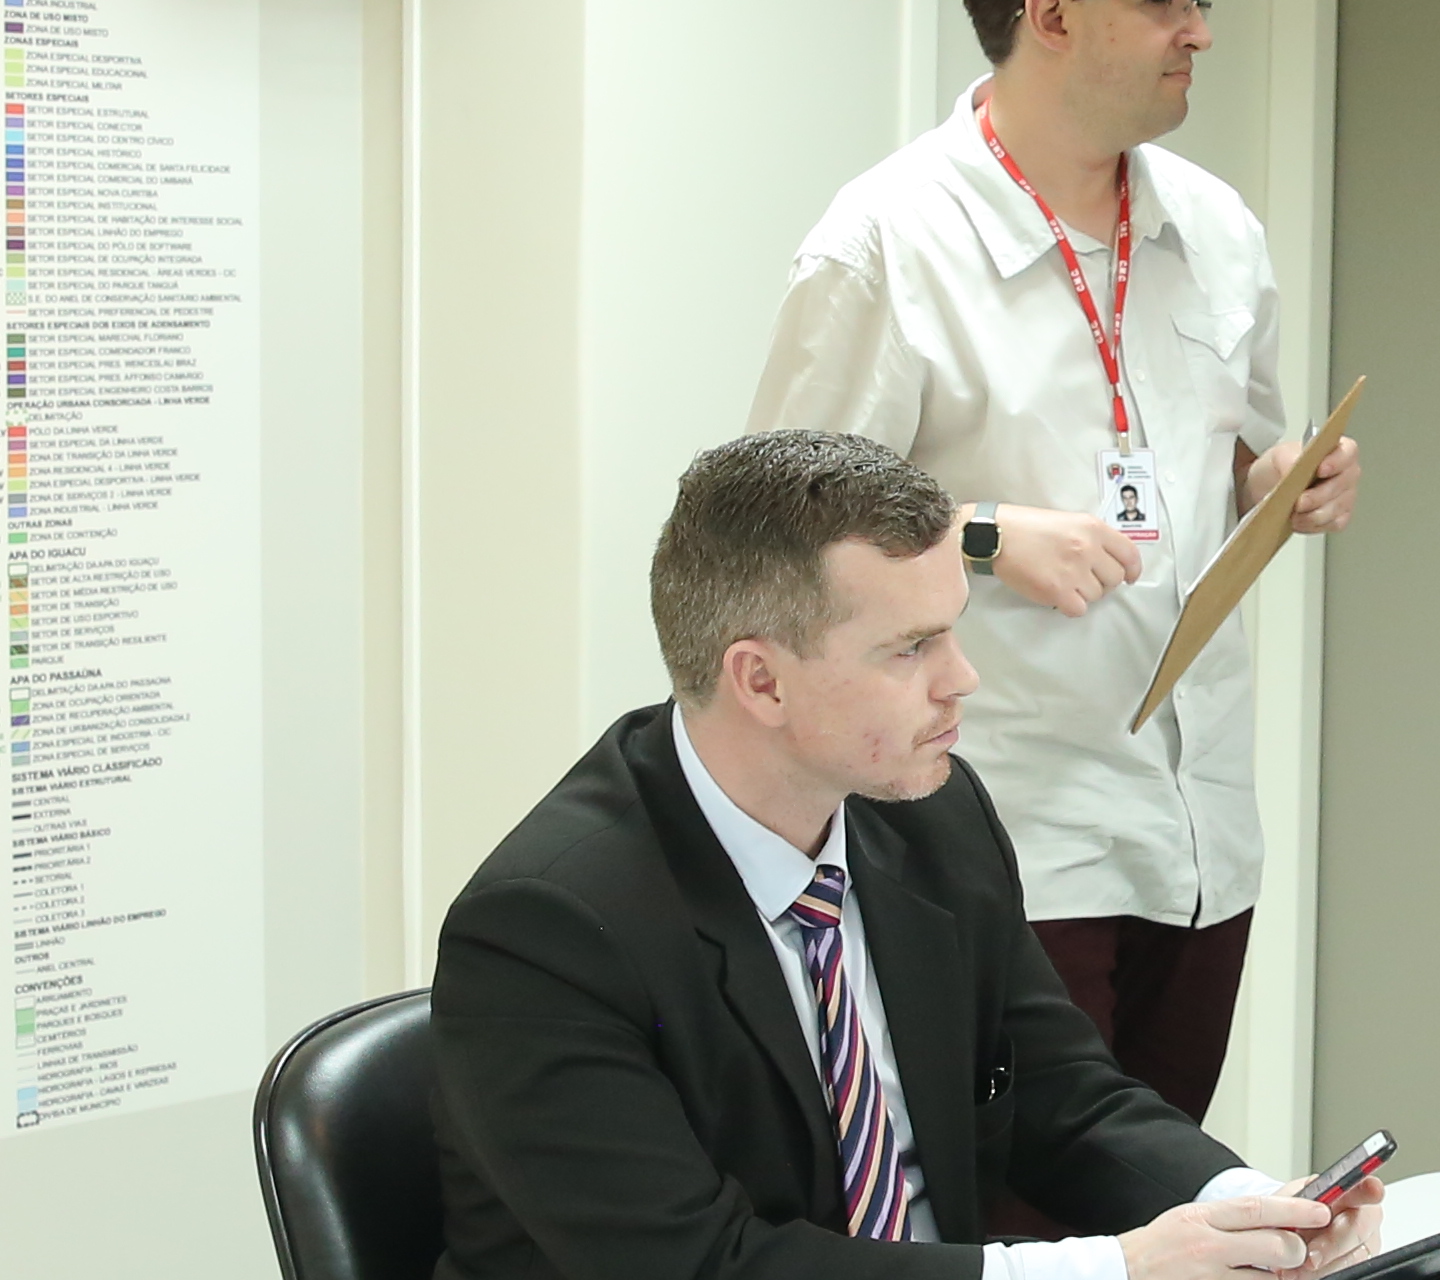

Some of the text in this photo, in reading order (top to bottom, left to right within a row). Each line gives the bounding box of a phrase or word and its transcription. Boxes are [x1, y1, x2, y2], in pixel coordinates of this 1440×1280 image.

[4, 10, 27, 19] ZONA
[30, 12, 40, 20] DE
[4, 37, 78, 48] ZONAS ESPECIAIS
[5, 92, 89, 103] SETORES ESPECIAIS
[9, 550, 28, 561] APA
[31, 549, 45, 559] DO
[10, 674, 30, 685] APA
[32, 673, 47, 683] DO
[12, 769, 54, 782] SISTEMA
[92, 757, 162, 775] CLASSIFICADO
[12, 785, 48, 796] SISTEMA
[12, 838, 48, 848] SISTEMA
[15, 974, 82, 994] CONVENÇÕES
